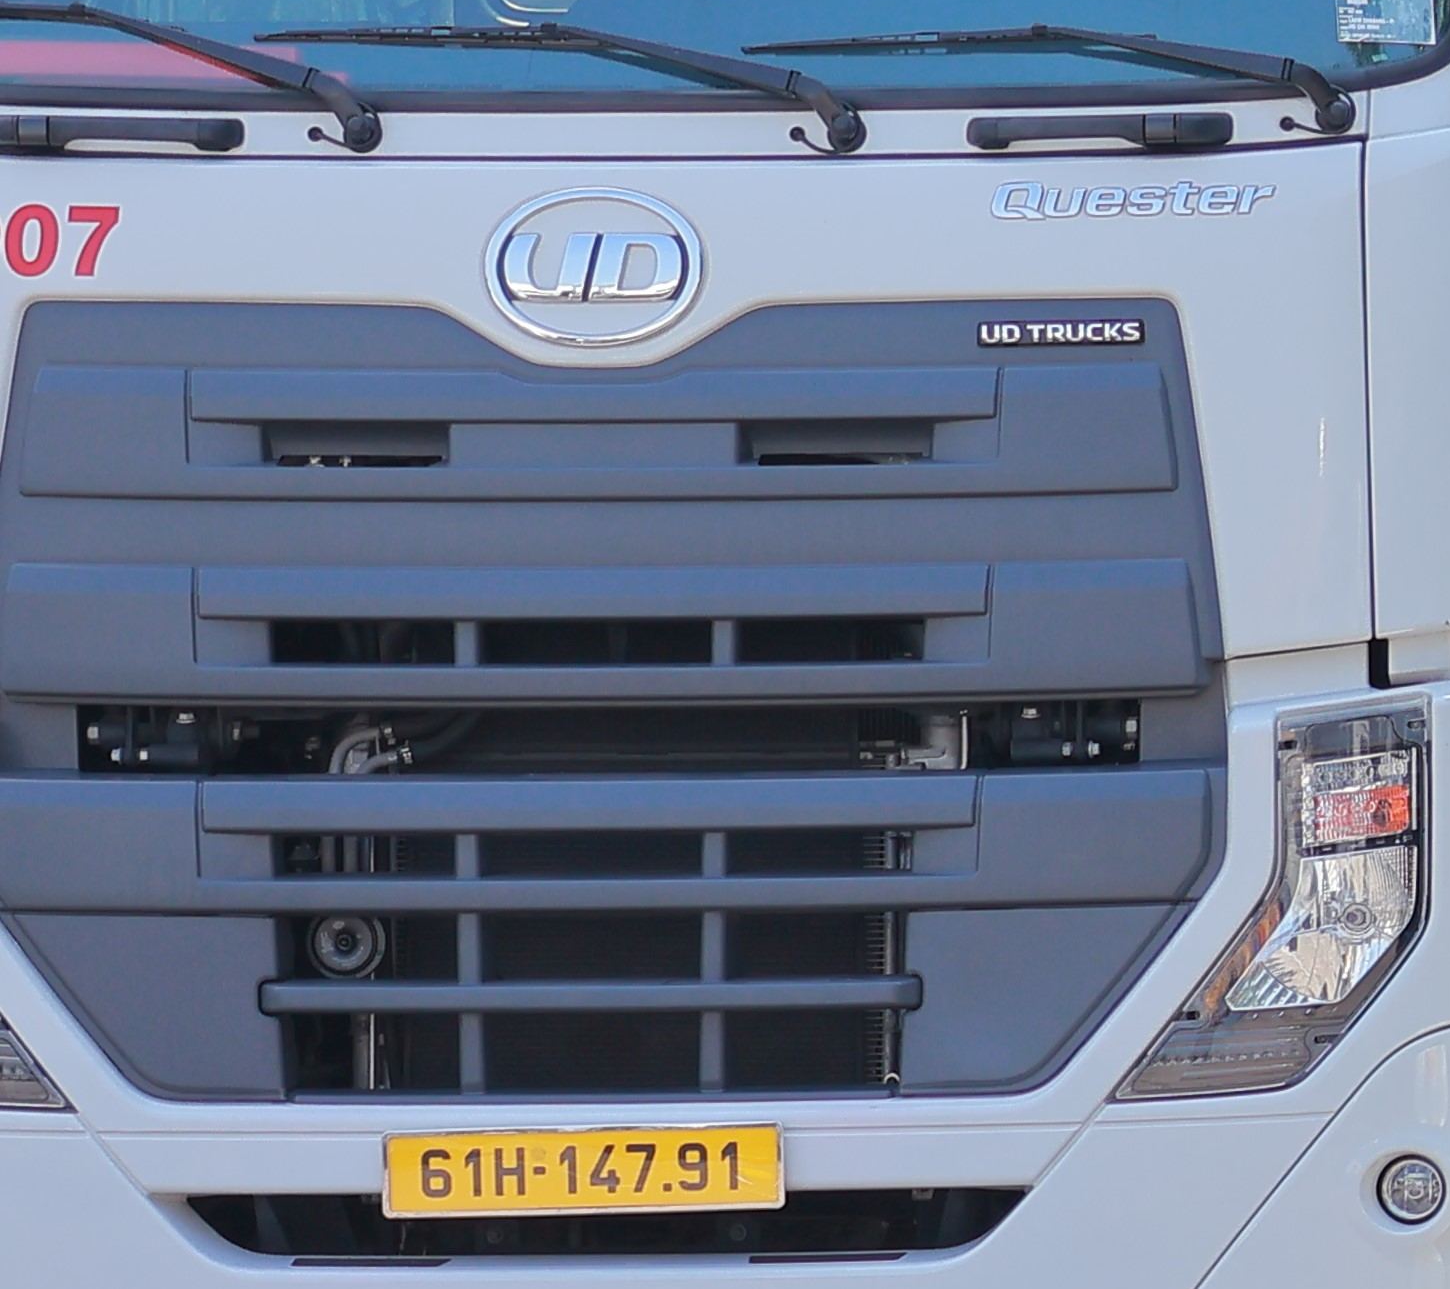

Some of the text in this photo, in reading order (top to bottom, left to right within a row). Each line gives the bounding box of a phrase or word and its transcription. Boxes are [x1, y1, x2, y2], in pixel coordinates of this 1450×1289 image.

[990, 180, 1277, 221] Quester
[5, 205, 120, 277] 07
[502, 231, 688, 302] UD
[981, 321, 1141, 345] UD TRUCKS
[420, 1141, 739, 1198] 61H-147.91
